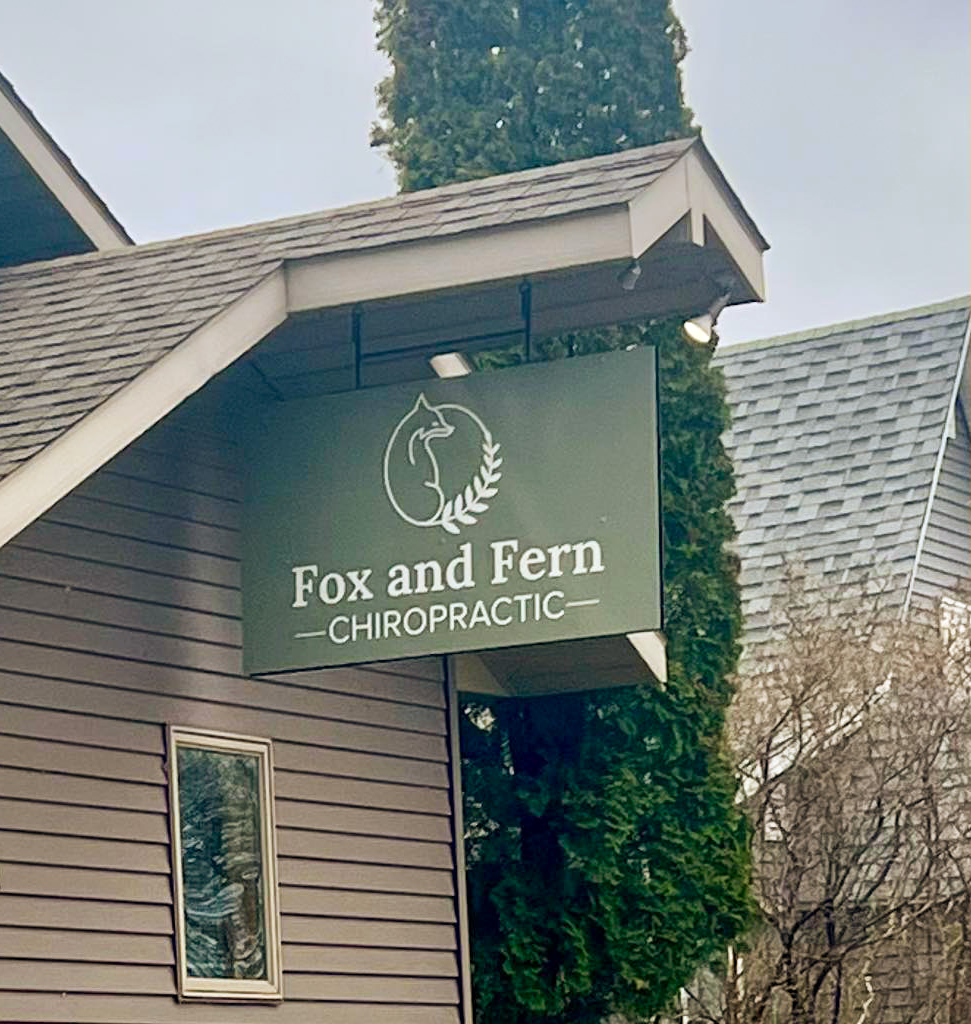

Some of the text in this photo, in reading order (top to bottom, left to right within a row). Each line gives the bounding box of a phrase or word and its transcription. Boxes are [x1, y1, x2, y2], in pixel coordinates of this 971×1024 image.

[291, 538, 605, 608] Fox and Fern
[328, 590, 566, 645] CHIROPRACTIC
